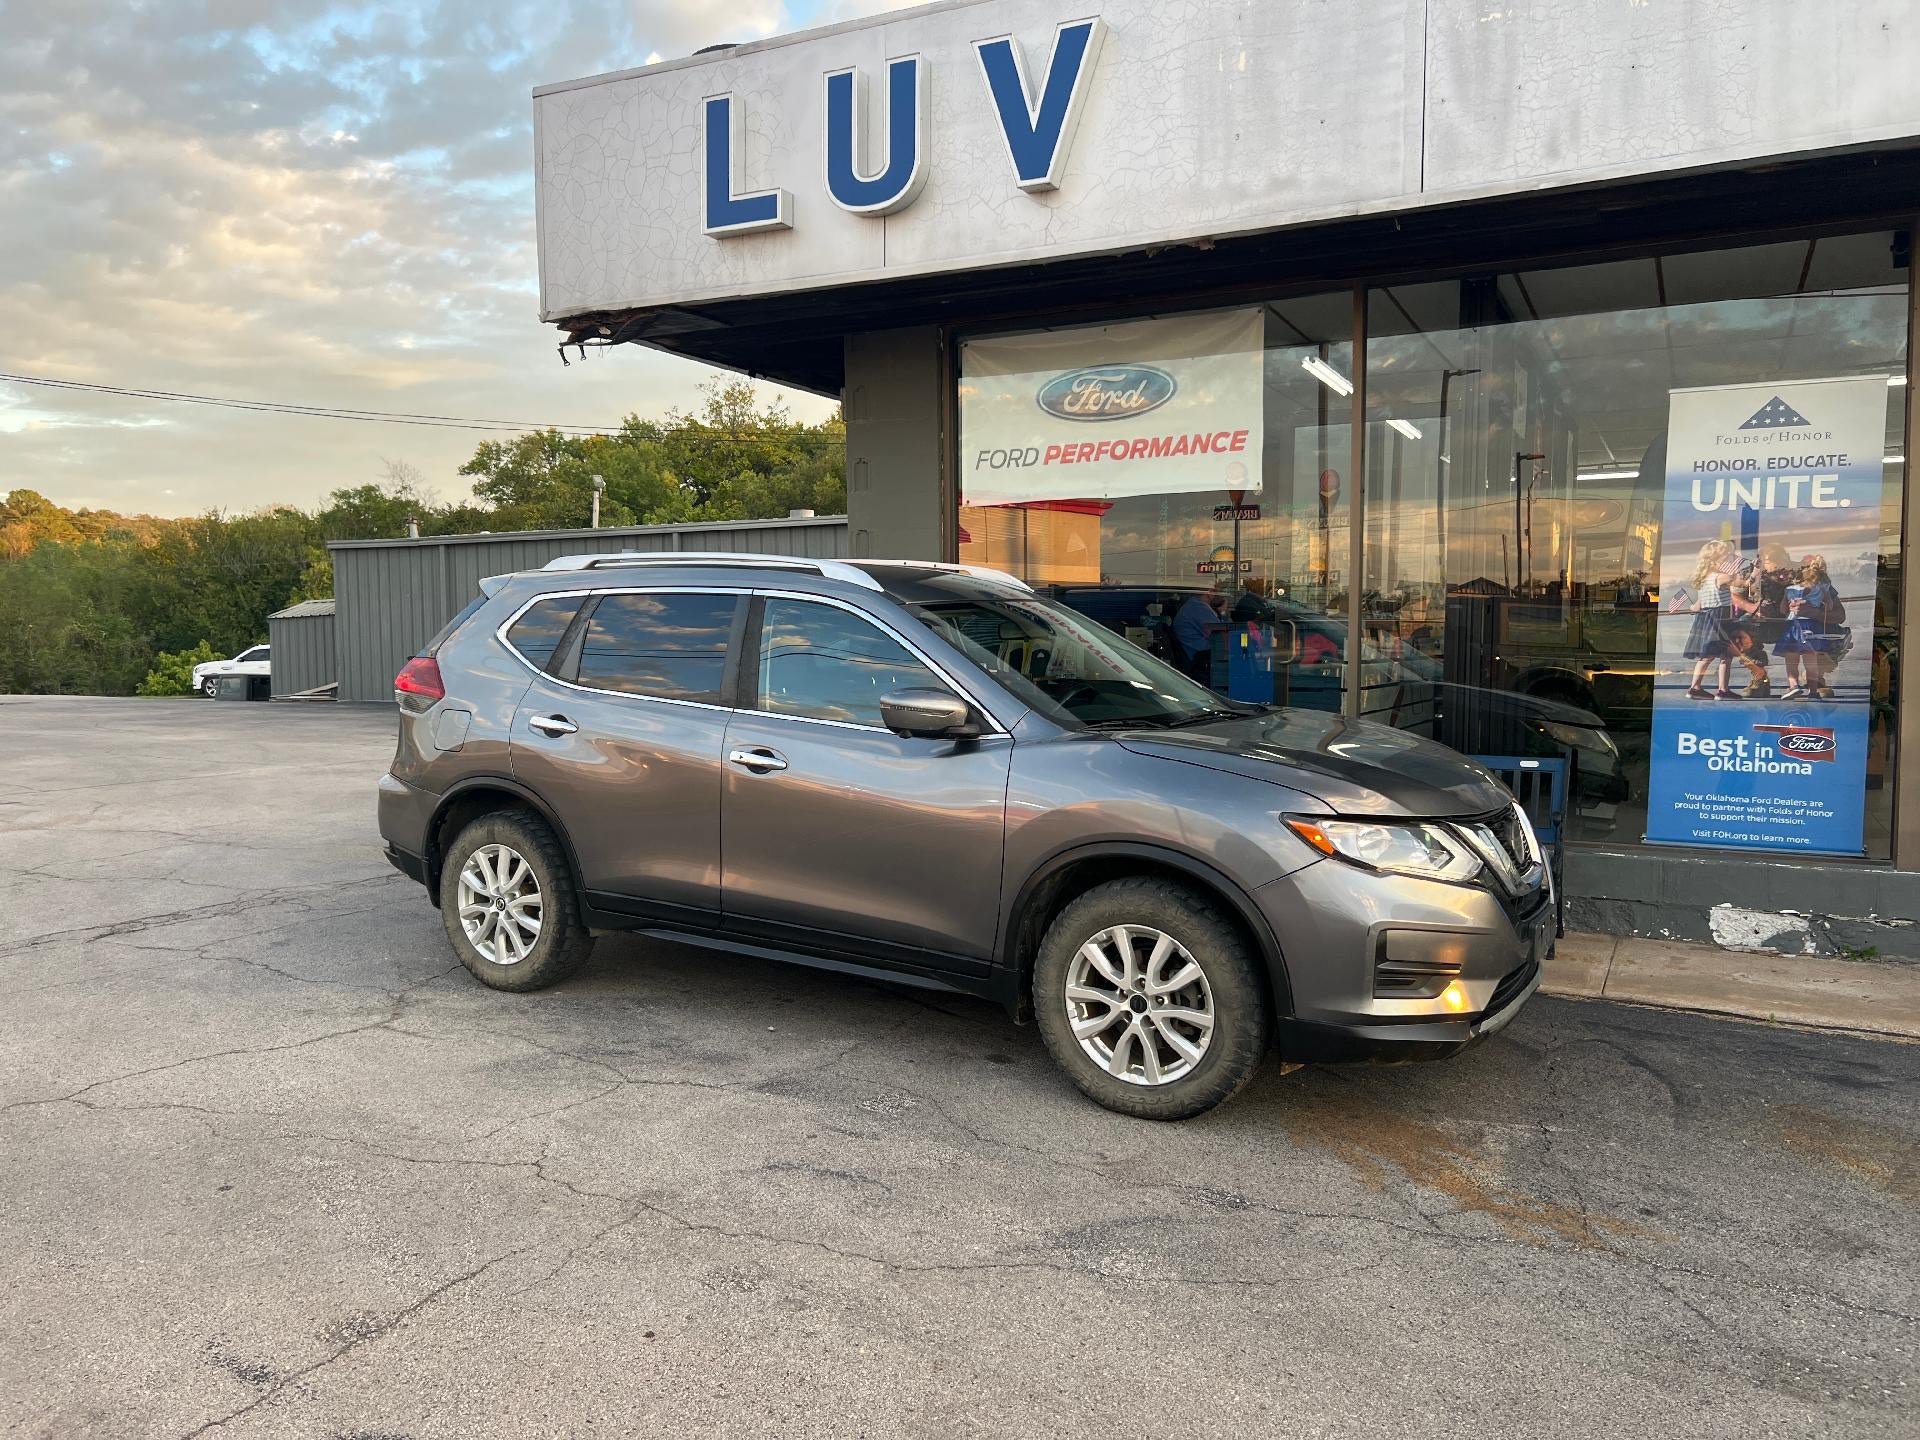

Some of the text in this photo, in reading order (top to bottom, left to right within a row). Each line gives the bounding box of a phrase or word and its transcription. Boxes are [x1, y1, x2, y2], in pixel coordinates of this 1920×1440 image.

[702, 15, 1107, 240] LUV
[1063, 373, 1148, 413] Ford
[1762, 432, 1776, 445] of
[1778, 431, 1833, 442] HONOR
[975, 429, 1250, 471] FORD PERFORMANCE
[1693, 453, 1852, 473] HONOR. EDUCATE.
[1691, 474, 1851, 512] UNITE.
[1677, 732, 1773, 759] Best in
[1788, 735, 1826, 750] Ford
[1707, 756, 1812, 776] Oklahoma
[1674, 801, 1700, 811] proud
[1712, 804, 1745, 812] partner
[1746, 805, 1766, 813] with
[1768, 806, 1793, 815] Folds
[1794, 808, 1805, 816] of
[1806, 809, 1834, 818] Honor
[1684, 792, 1824, 808] Your Oklahoma Ford Dealers are
[1710, 813, 1745, 822] support
[1746, 814, 1768, 823] their
[1769, 816, 1806, 825] mission.
[1692, 829, 1711, 838] Visit
[1712, 830, 1748, 841] FOH.org
[1750, 833, 1760, 841] to
[1761, 833, 1784, 842] learn
